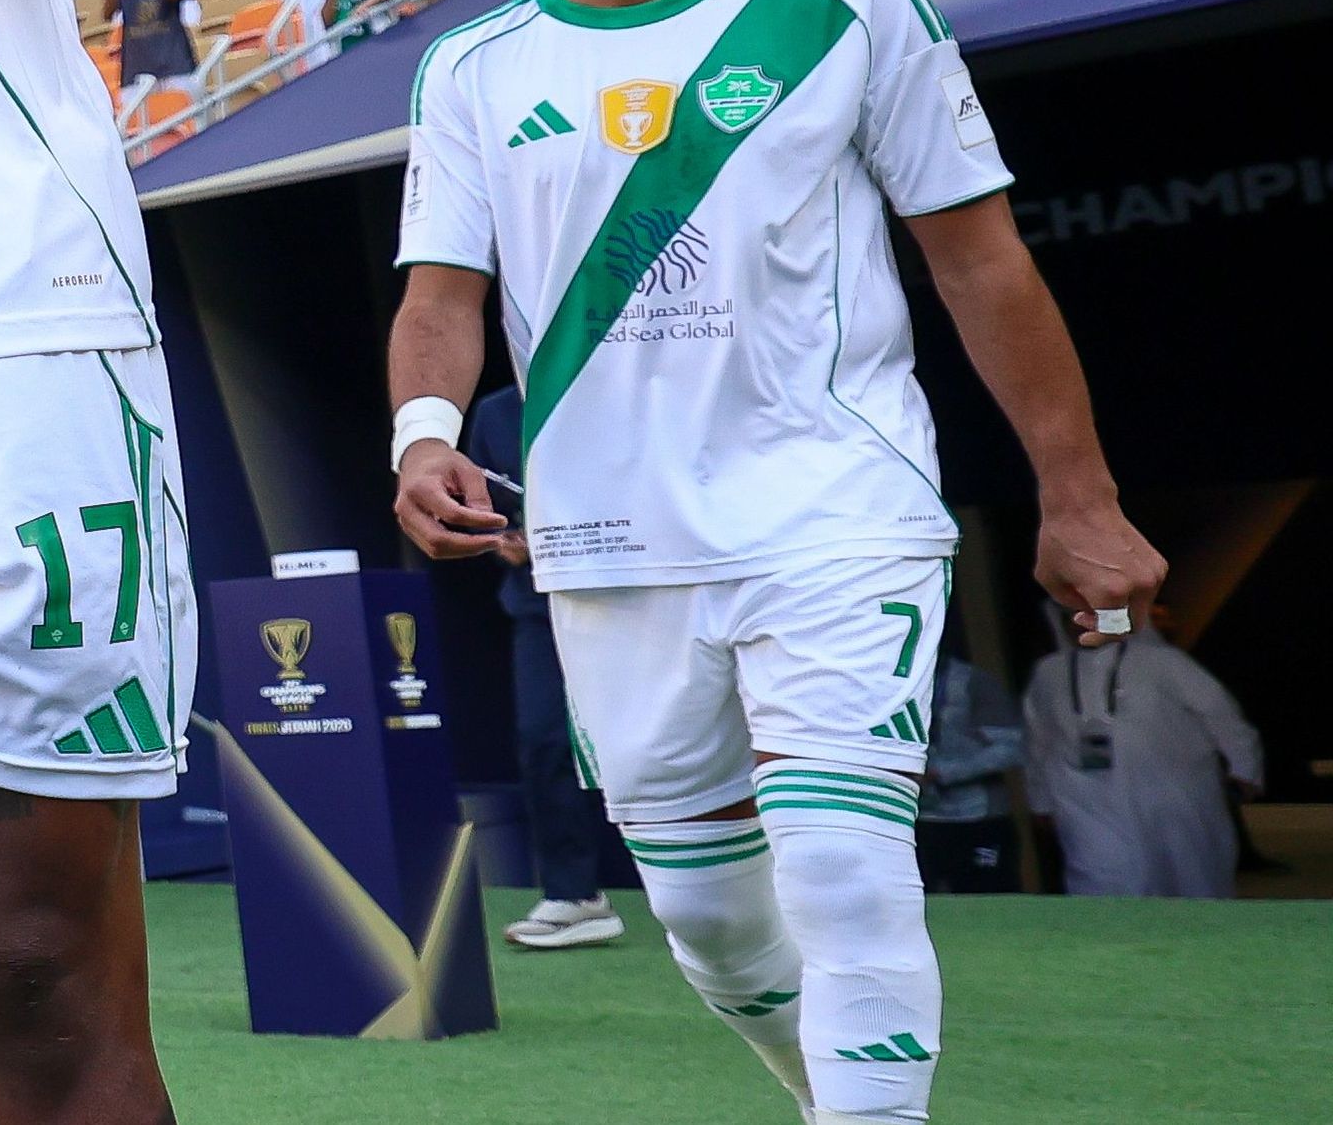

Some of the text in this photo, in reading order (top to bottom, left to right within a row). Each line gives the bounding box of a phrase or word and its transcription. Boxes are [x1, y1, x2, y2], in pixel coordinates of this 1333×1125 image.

[1011, 156, 1333, 247] CHAMPI
[52, 274, 104, 288] AEROREADY
[630, 327, 665, 342] Sea
[669, 320, 734, 340] Global
[15, 500, 142, 650] 17
[880, 600, 924, 678] 7
